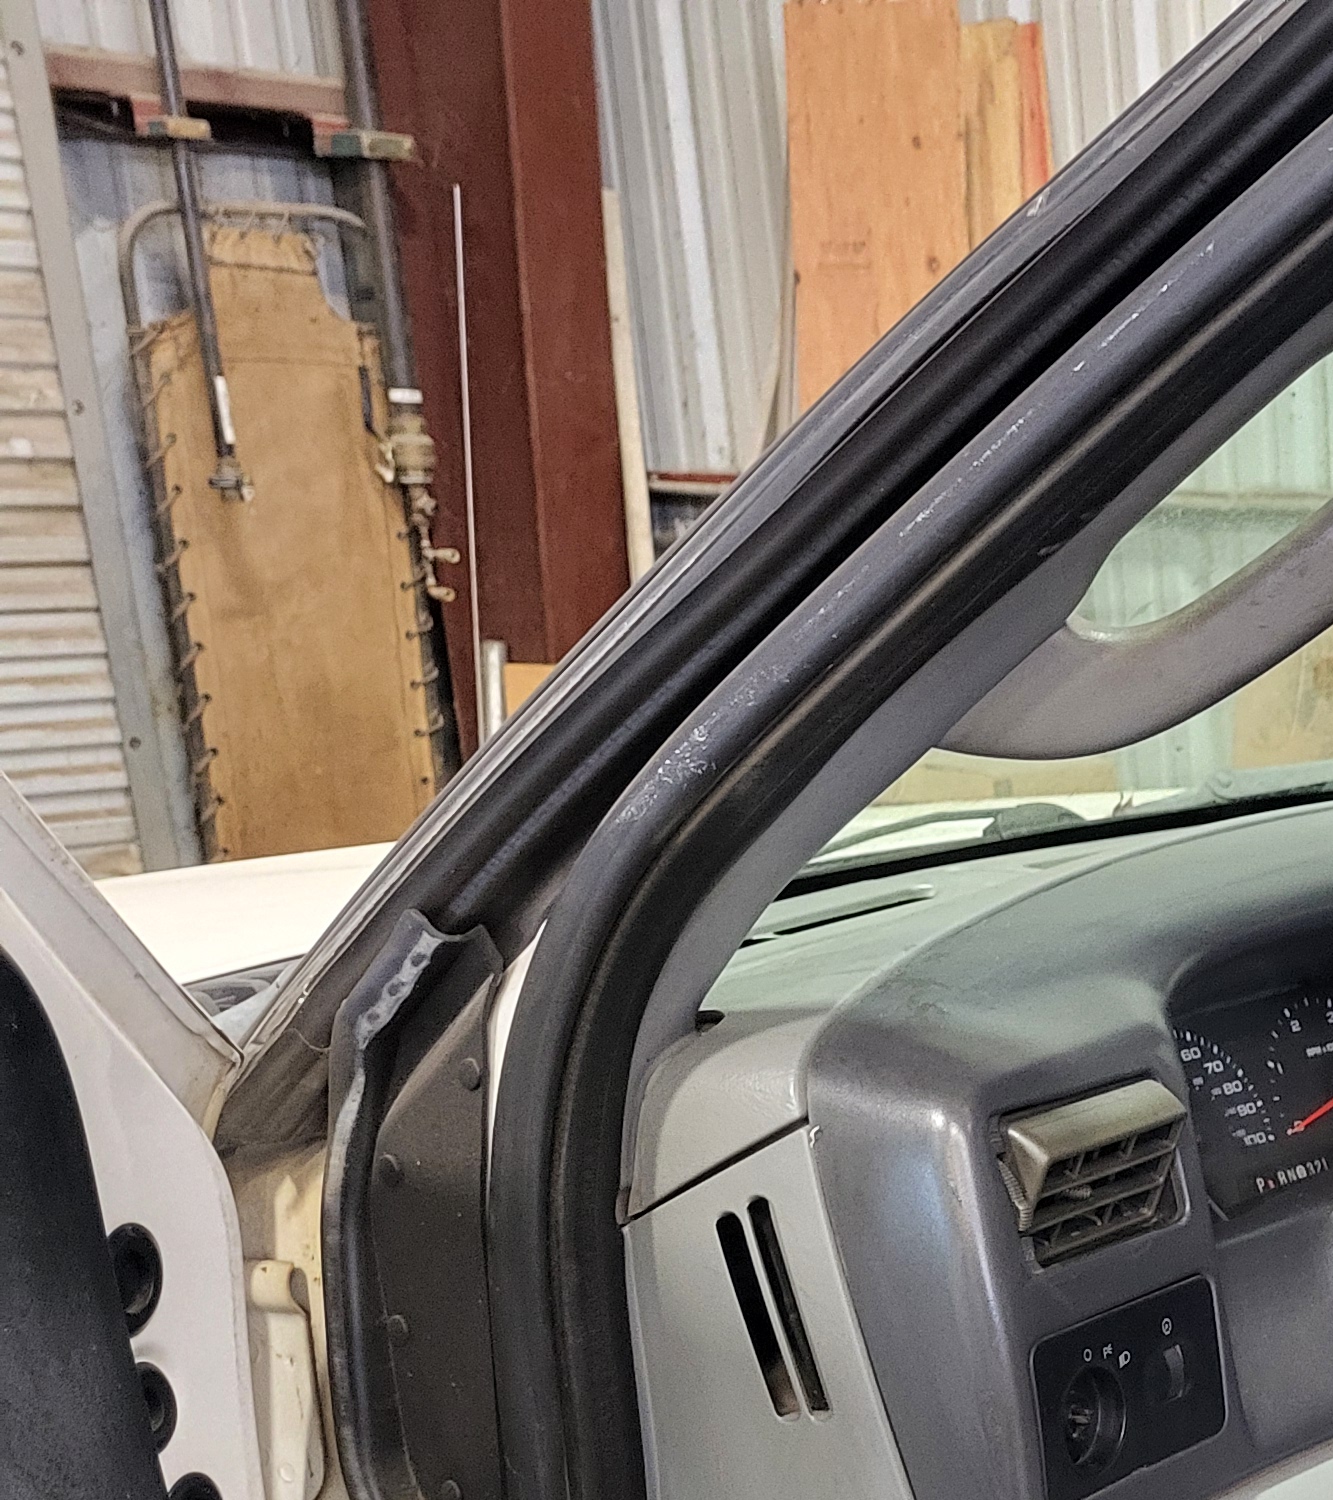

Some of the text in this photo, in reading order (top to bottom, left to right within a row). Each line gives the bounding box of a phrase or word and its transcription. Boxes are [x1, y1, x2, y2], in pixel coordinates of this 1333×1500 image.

[1290, 1020, 1301, 1032] 2
[1180, 1046, 1201, 1062] 60
[1203, 1060, 1224, 1074] 70
[1222, 1080, 1243, 1095] 80
[1236, 1102, 1257, 1117] 90
[1243, 1131, 1267, 1146] 100
